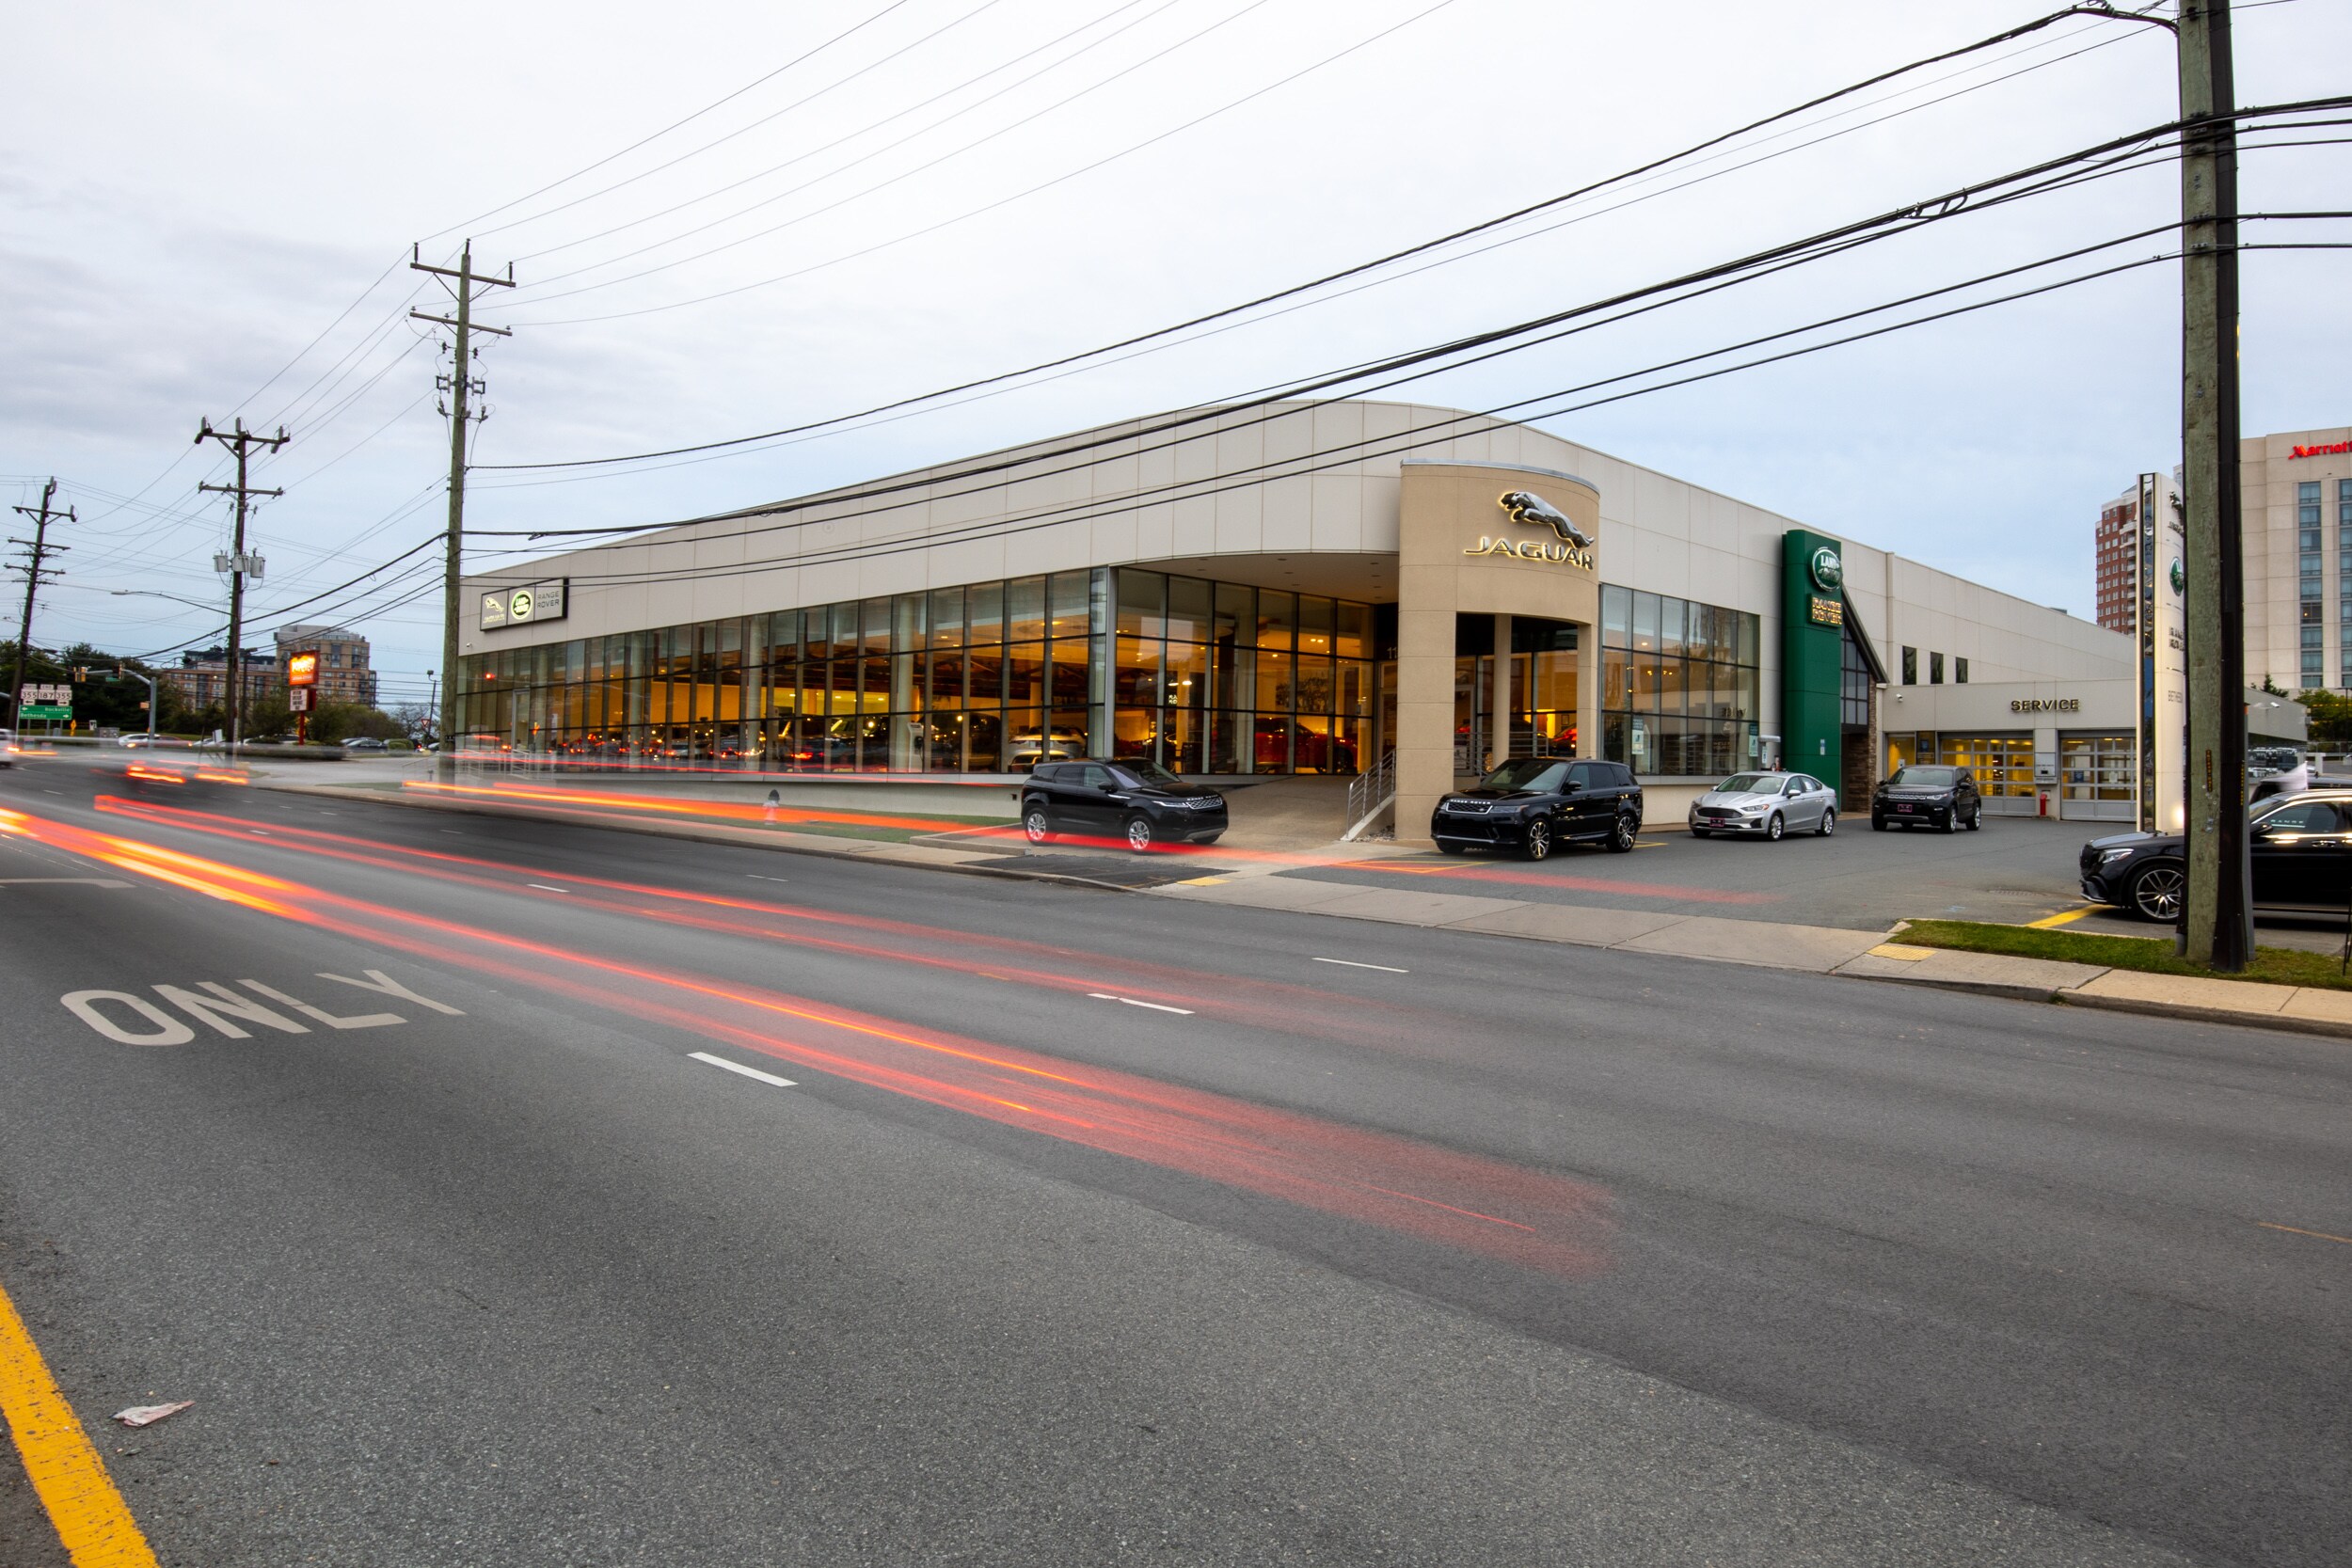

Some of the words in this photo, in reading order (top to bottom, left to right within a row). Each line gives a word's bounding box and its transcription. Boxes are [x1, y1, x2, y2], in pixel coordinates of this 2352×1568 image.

[1464, 536, 1594, 571] JAGUAR
[537, 591, 560, 599] RANGE
[537, 598, 560, 609] ROVER
[1812, 597, 1842, 613] RANGE
[1812, 609, 1842, 625] ROVER
[2010, 699, 2080, 713] SERVICE
[60, 970, 467, 1046] ONLY
